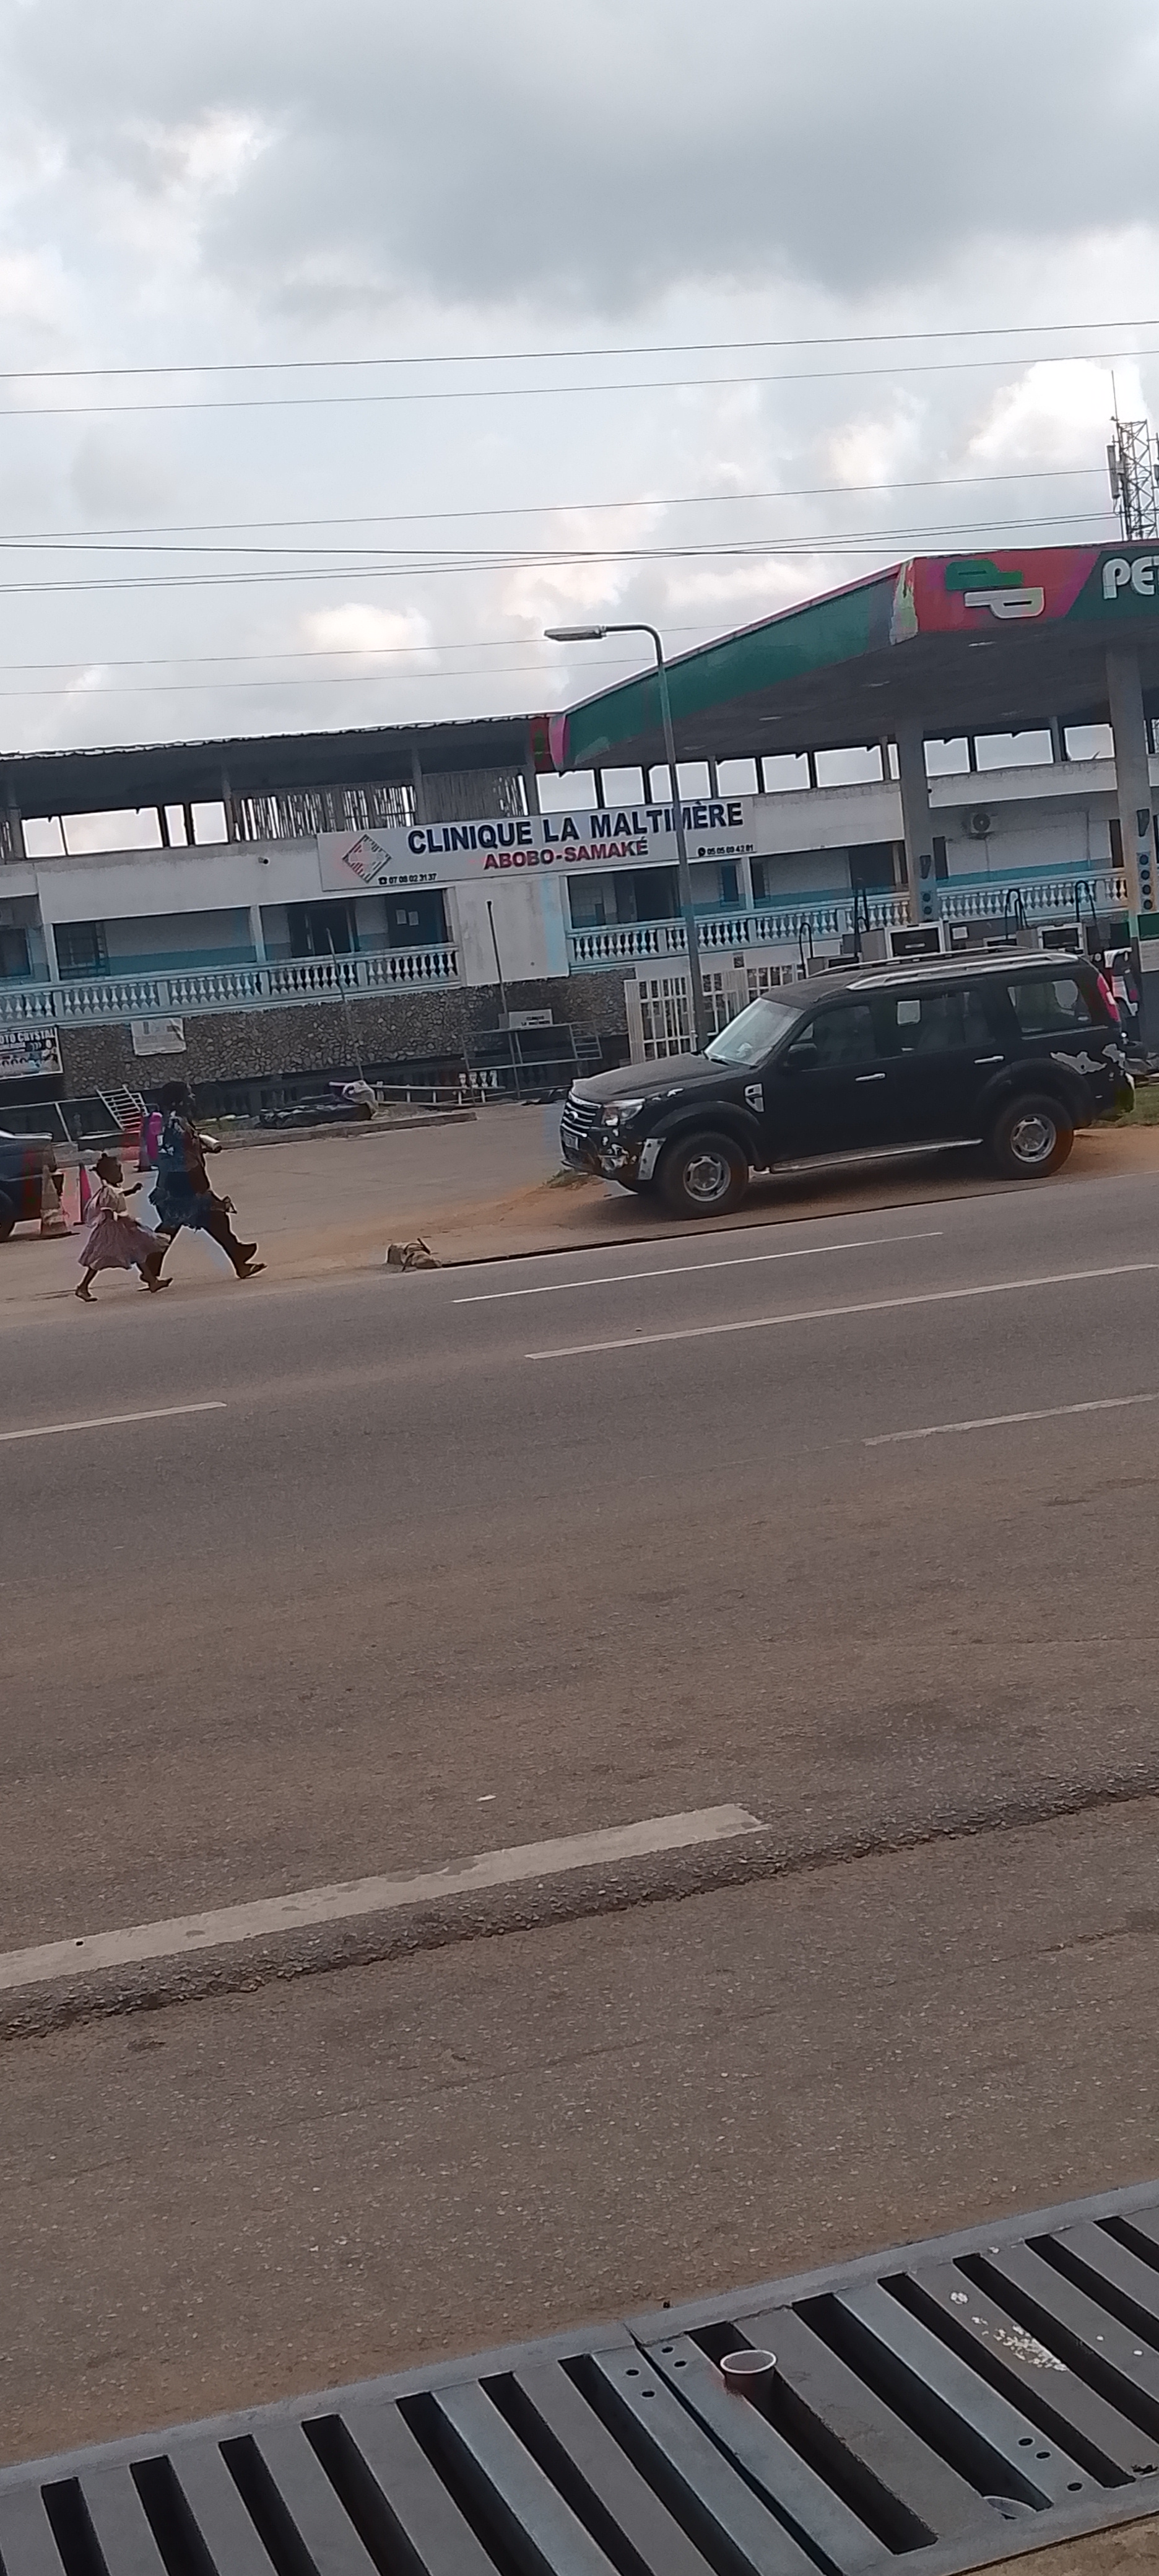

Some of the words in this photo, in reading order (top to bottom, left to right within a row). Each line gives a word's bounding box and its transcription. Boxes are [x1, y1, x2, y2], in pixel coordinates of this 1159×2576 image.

[1103, 555, 1159, 599] PE
[407, 821, 532, 855] CLINIQUE
[542, 817, 580, 843] LA
[590, 801, 743, 838] MALTIMÈRE
[483, 836, 648, 871] ABOBO-SAMAKÉ
[389, 876, 397, 884] 07
